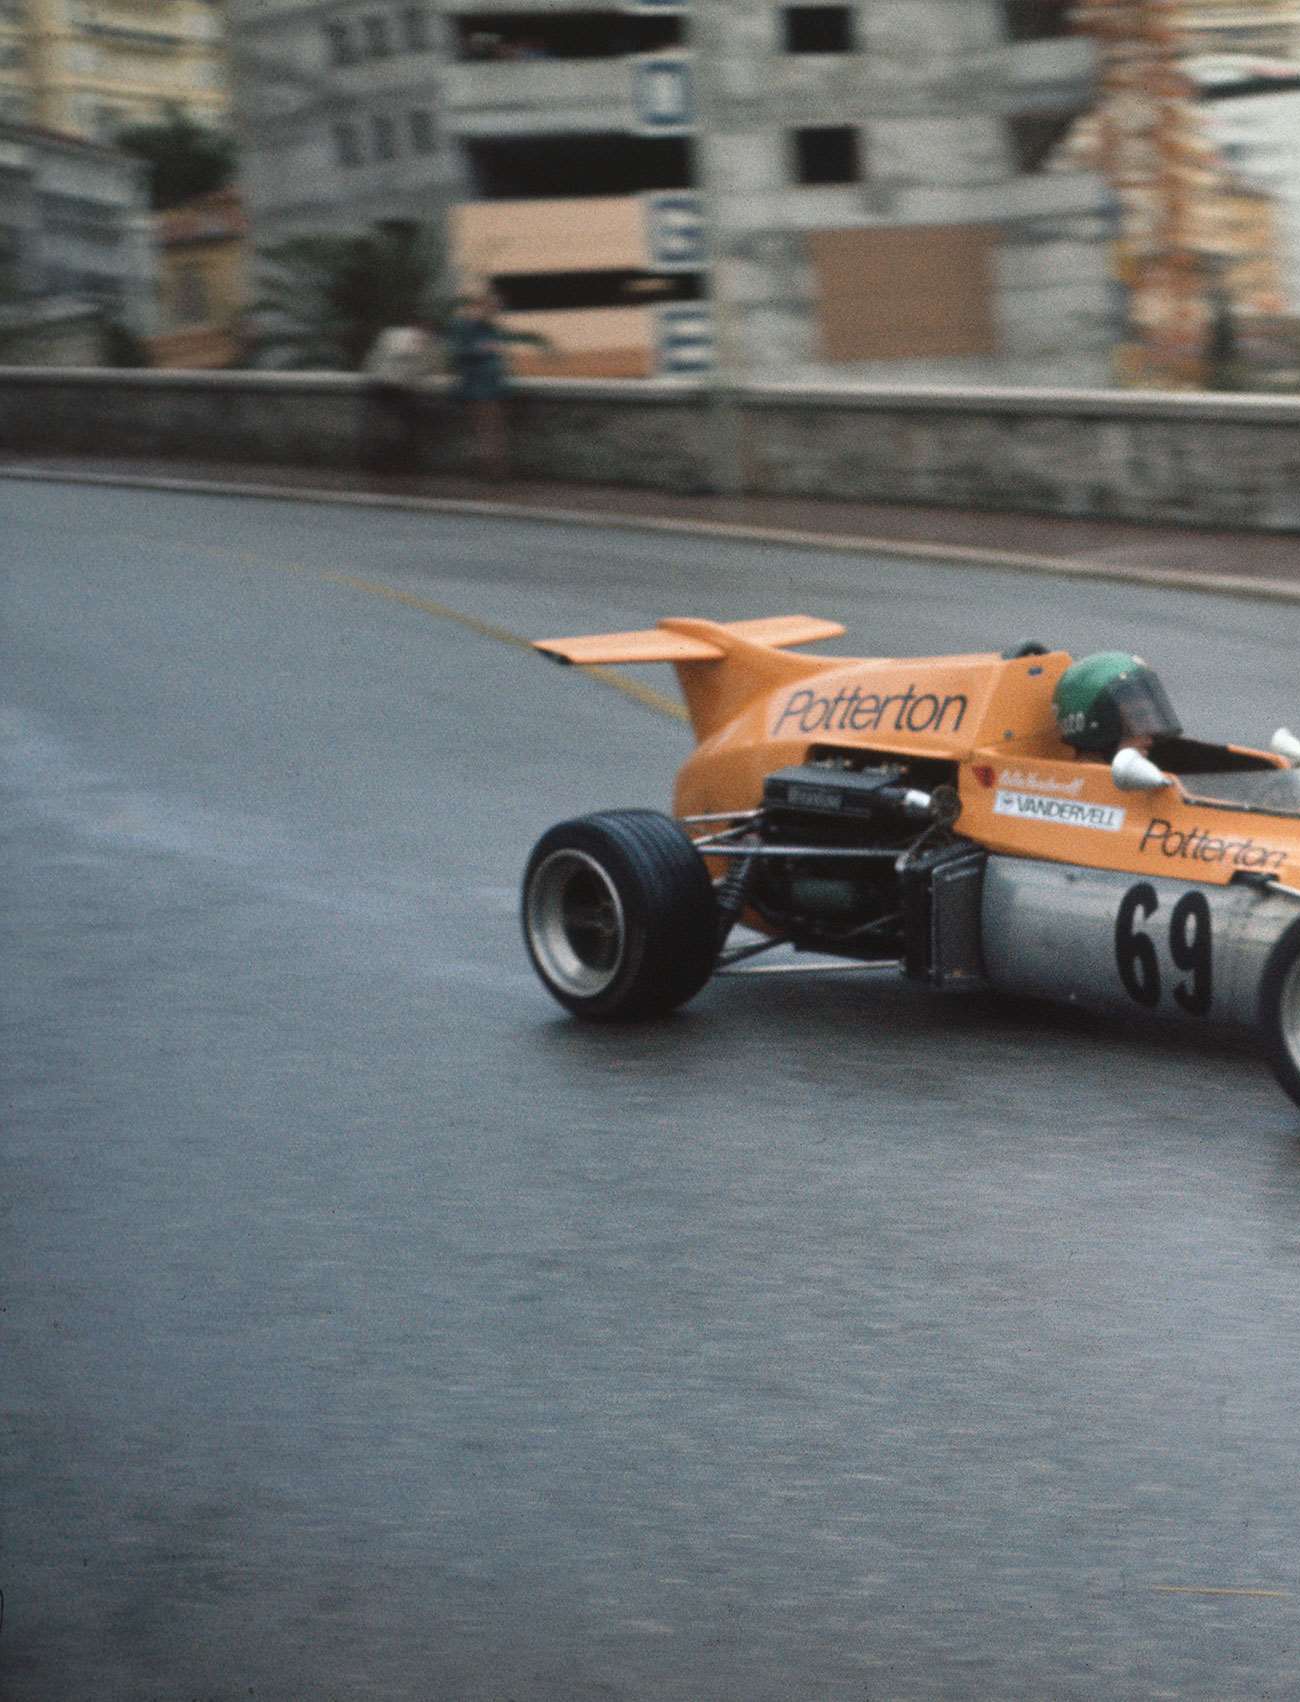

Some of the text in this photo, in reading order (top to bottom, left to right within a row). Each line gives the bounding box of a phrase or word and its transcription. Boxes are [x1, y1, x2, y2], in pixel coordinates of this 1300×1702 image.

[772, 684, 968, 737] Potterton
[1017, 795, 1115, 826] VANDERVELL
[1139, 818, 1288, 869] Potterton
[1115, 881, 1212, 1017] 69
